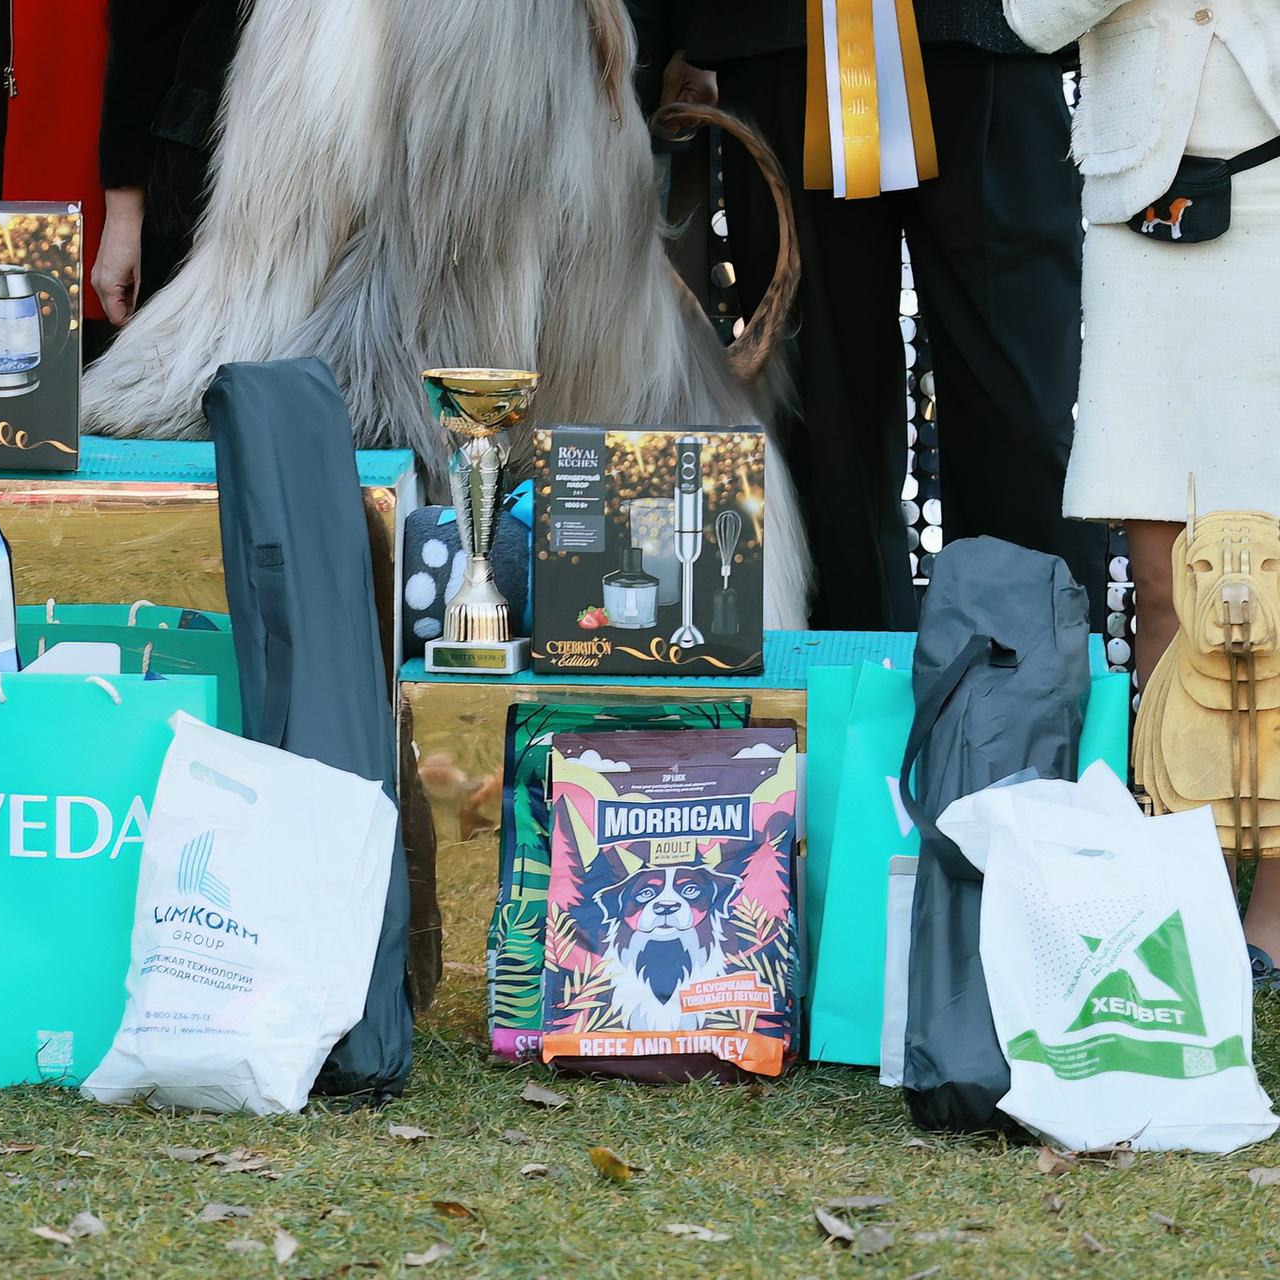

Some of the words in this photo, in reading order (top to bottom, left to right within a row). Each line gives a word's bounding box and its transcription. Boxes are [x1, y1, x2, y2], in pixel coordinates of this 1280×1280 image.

[840, 66, 871, 88] SHOW
[558, 447, 598, 459] ROYAL
[546, 638, 612, 656] CELEBRATION
[558, 654, 600, 667] Edition
[605, 804, 743, 837] MORRIGAN
[655, 841, 691, 854] ADULT
[154, 905, 258, 945] LIMKORM
[172, 929, 224, 950] GROUP
[186, 960, 253, 985] ТЕХНОЛОГИИ
[192, 974, 253, 993] СТАНДАРТЫ
[703, 980, 755, 993] КУСОЧКАМИ
[683, 991, 732, 1007] ГОВЯЖЬЕГО
[733, 991, 768, 1003] ЛЕГКОГО
[1091, 996, 1186, 1025] ХЕЛВЕТ
[675, 1036, 749, 1061] TURKEY
